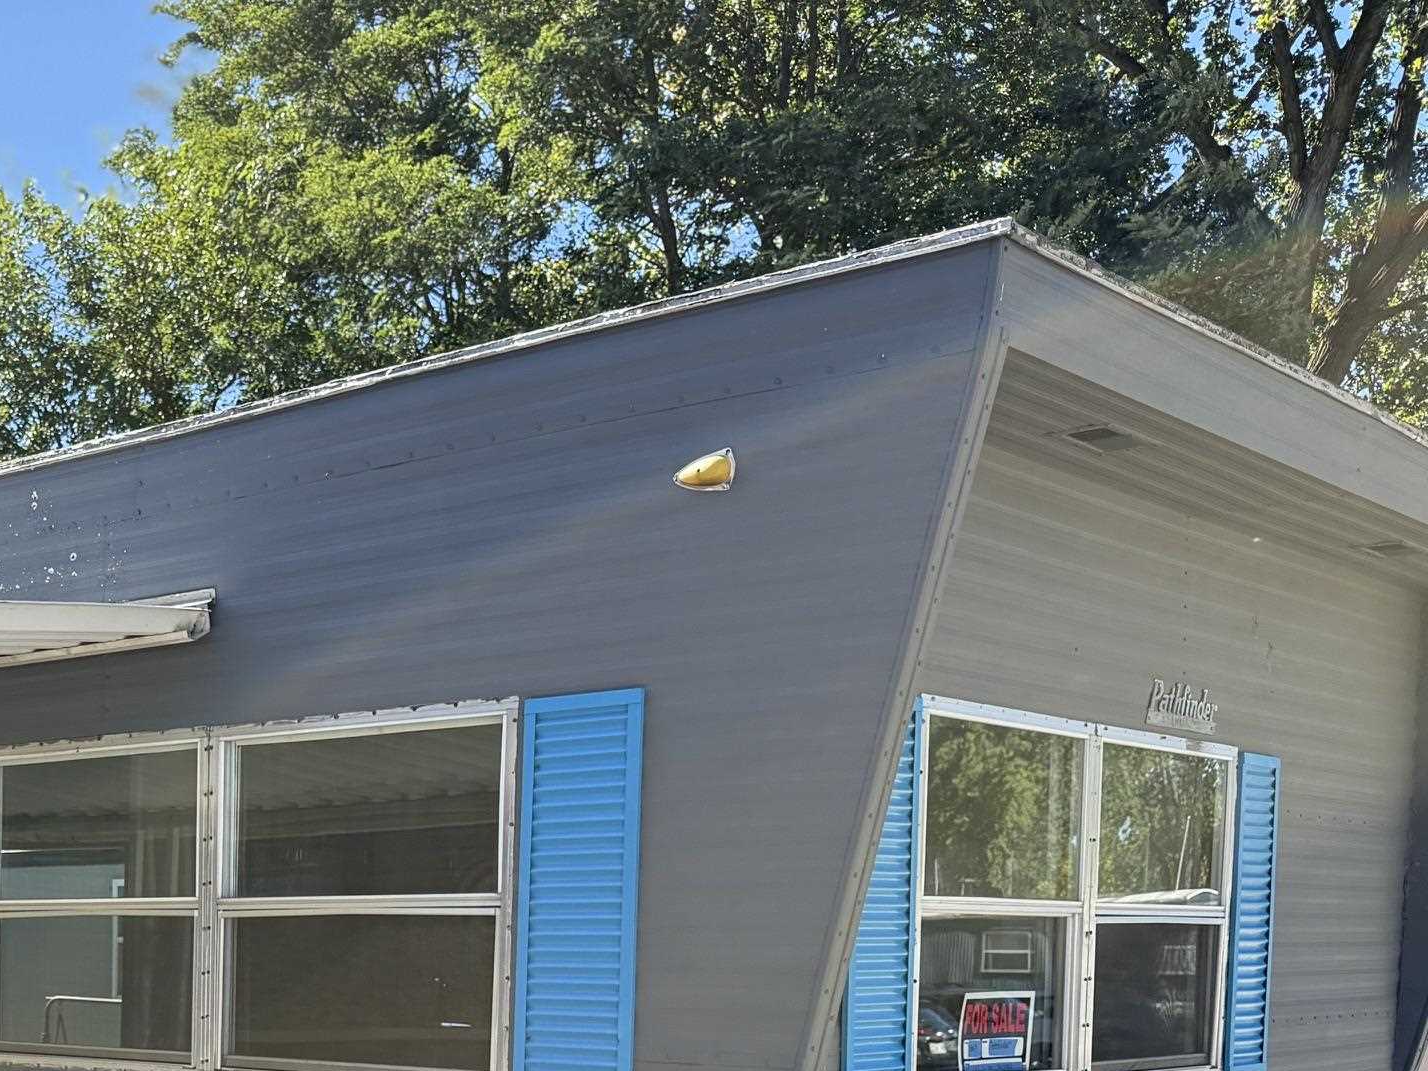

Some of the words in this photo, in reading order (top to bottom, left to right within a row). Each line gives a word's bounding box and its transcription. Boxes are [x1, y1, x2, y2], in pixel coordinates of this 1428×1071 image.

[1147, 679, 1218, 721] Pathfinder
[964, 1003, 988, 1034] FOR
[992, 1002, 1028, 1033] SALE
